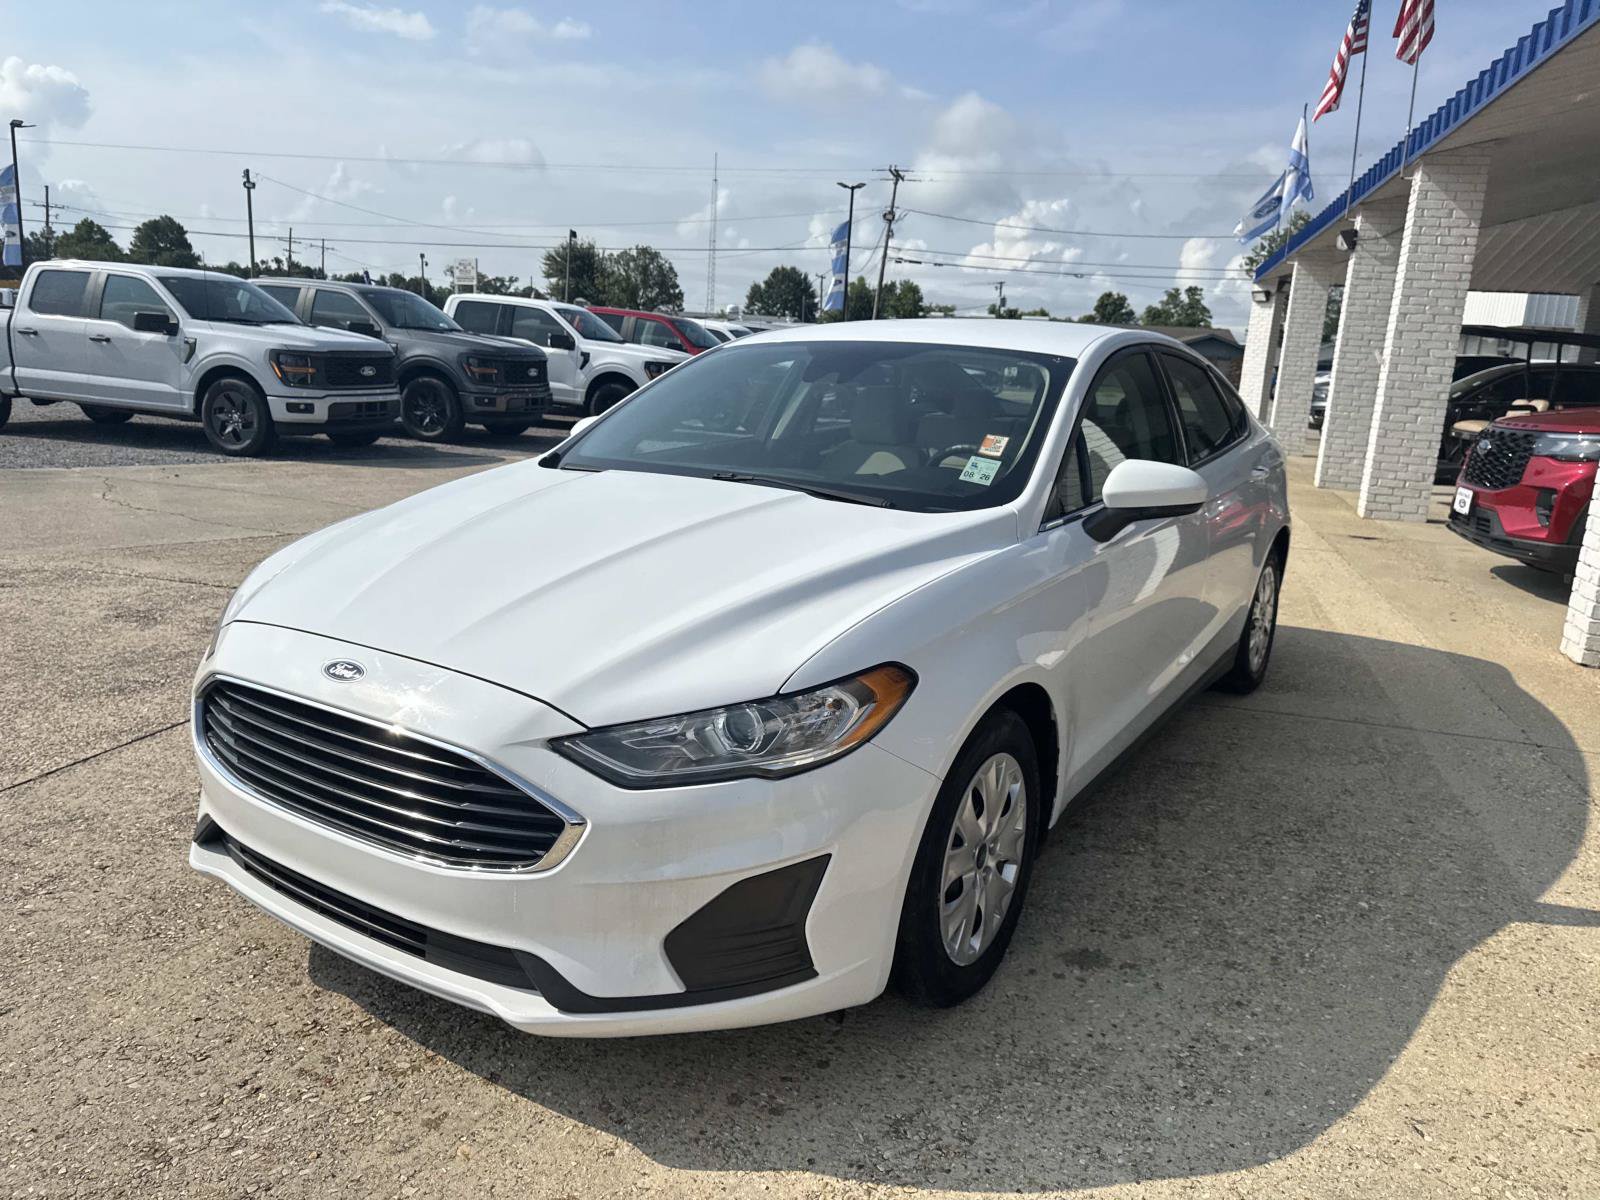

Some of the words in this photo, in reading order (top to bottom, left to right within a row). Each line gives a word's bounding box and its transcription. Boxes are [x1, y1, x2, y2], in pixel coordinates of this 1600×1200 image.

[963, 470, 975, 478] 08
[979, 473, 991, 481] 26
[327, 661, 361, 679] Ford
